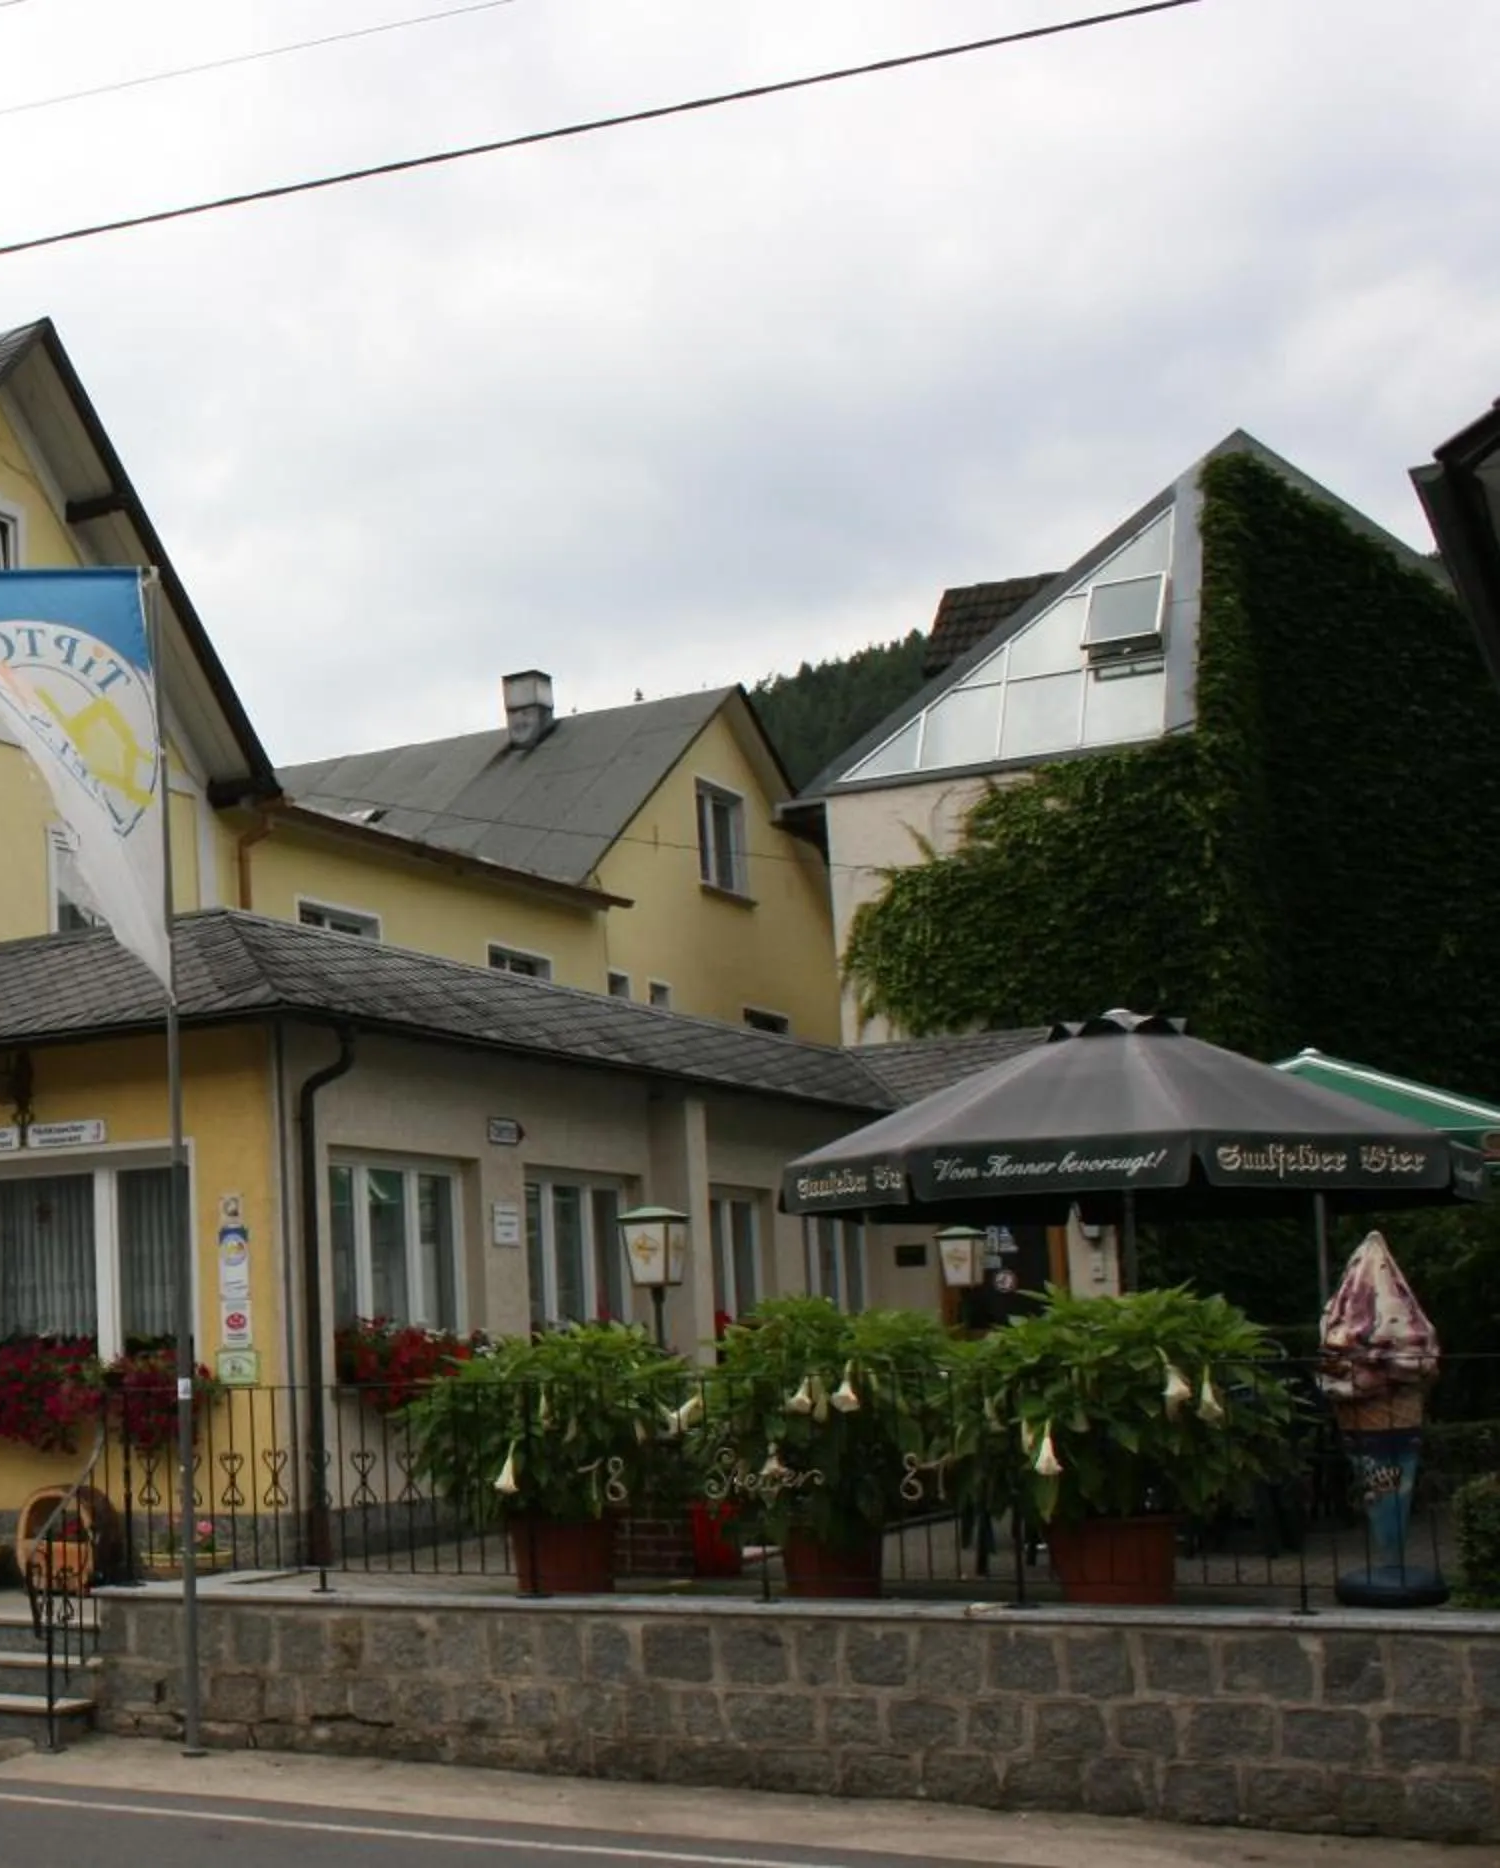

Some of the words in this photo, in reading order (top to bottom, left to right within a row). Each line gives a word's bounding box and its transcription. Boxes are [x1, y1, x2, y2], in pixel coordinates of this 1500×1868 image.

[932, 1159, 978, 1181] Vom
[981, 1153, 1057, 1178] Kenner
[1057, 1148, 1168, 1177] bevorzugt!
[1359, 1144, 1427, 1173] Bier
